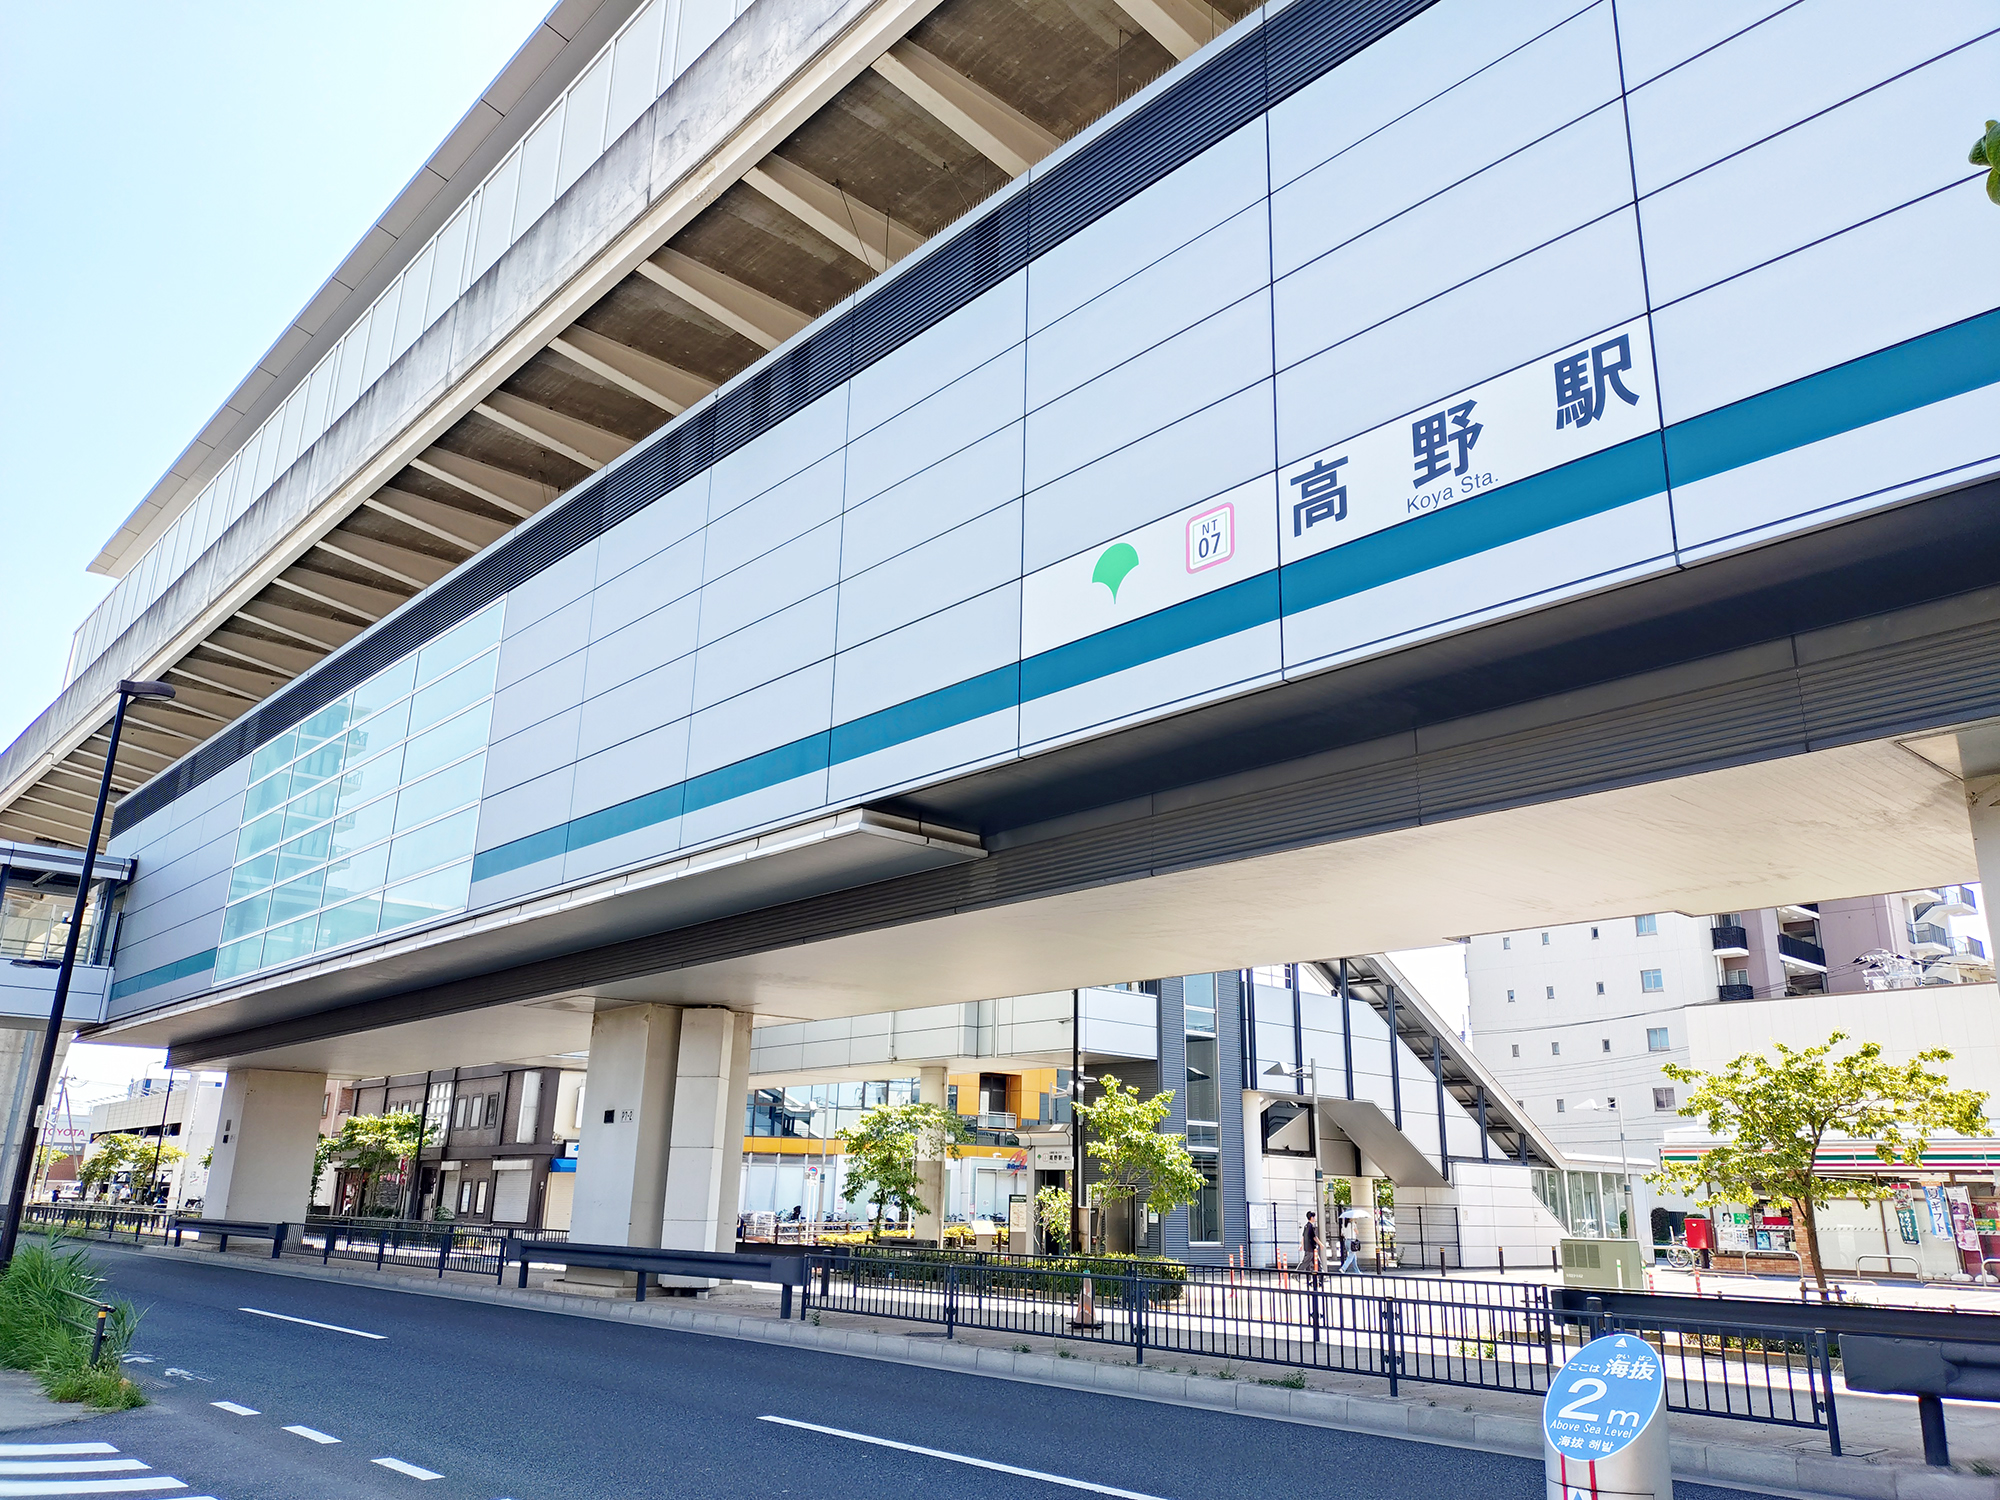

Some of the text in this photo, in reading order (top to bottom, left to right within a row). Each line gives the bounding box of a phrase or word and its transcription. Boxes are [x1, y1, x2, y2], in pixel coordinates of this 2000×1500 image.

[1290, 333, 1640, 538] 高野駅
[1406, 471, 1499, 514] Koya Sta.
[1202, 518, 1218, 536] NT
[1198, 531, 1221, 558] 07
[1602, 1358, 1657, 1382] 海抜
[1557, 1377, 1640, 1428] 2 m
[1550, 1419, 1633, 1439] Above Sea Level
